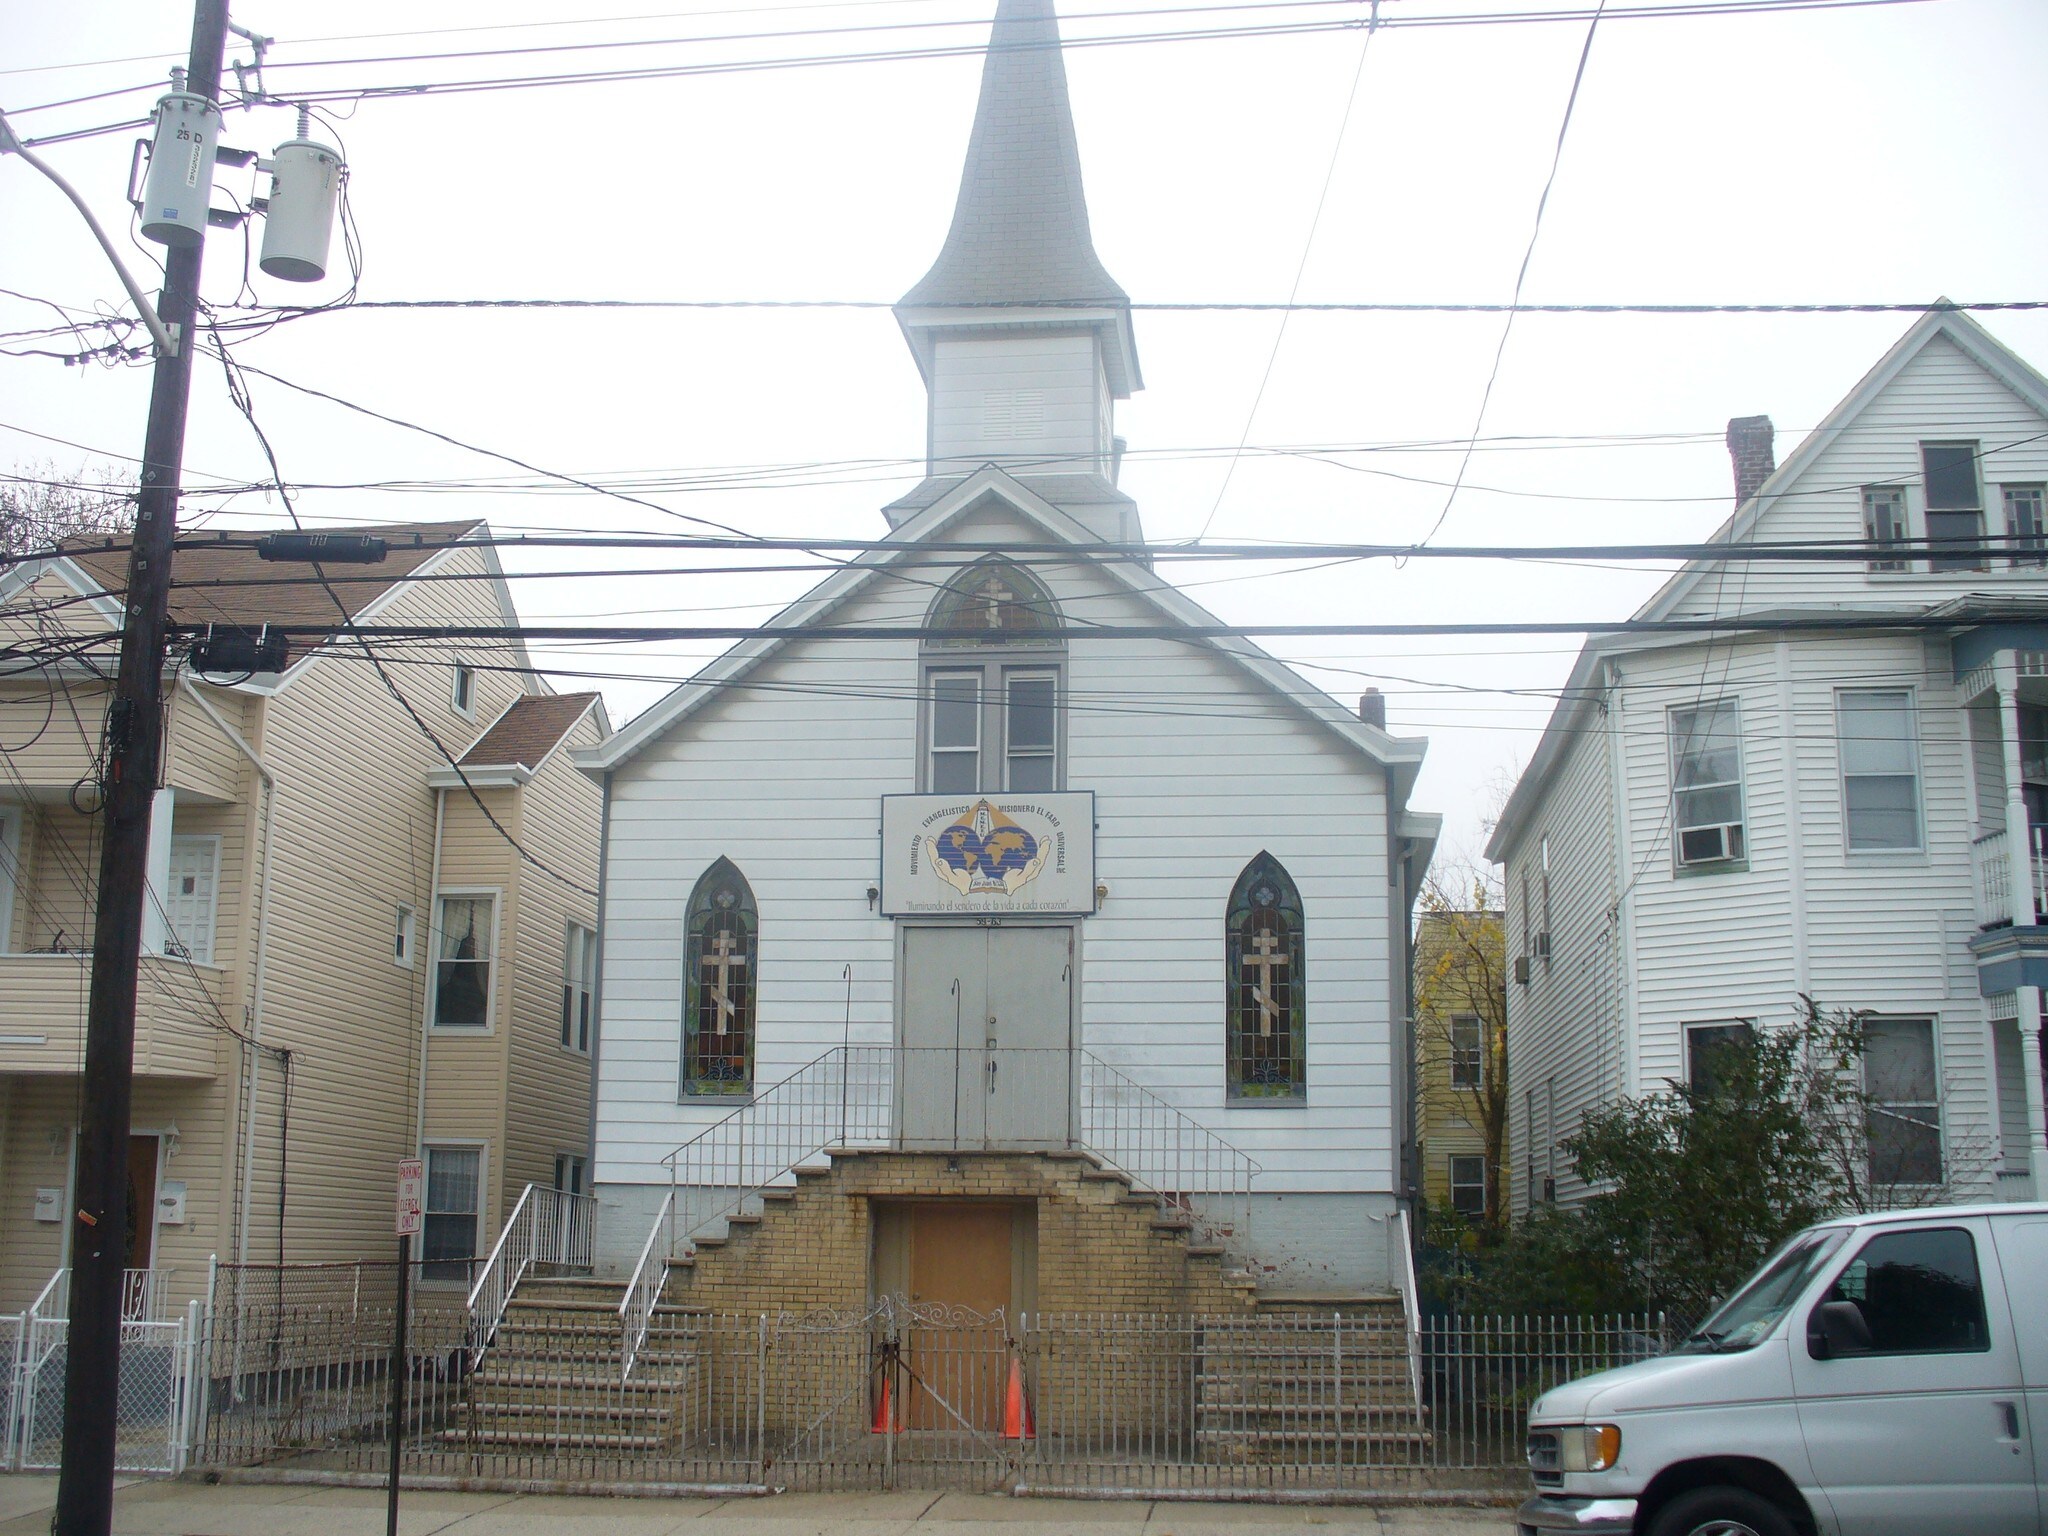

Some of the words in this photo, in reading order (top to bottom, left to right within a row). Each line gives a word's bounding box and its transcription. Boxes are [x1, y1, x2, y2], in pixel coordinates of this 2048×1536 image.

[177, 129, 190, 141] 25
[194, 132, 203, 144] D
[910, 834, 922, 876] MOVIMIENTO
[922, 805, 970, 828] EVANGELISTICO
[998, 805, 1035, 813] MISIONERO
[1036, 807, 1044, 816] EL
[1044, 811, 1061, 828] FARO
[1056, 831, 1065, 867] UNIVERSAL
[946, 900, 953, 911] el
[954, 900, 981, 911] sendero
[982, 900, 992, 911] de
[993, 900, 999, 911] la
[1001, 900, 1015, 911] vida
[1016, 903, 1021, 911] a
[1022, 899, 1038, 911] cada
[401, 1165, 421, 1179] PARKING
[405, 1184, 413, 1194] FOR
[400, 1198, 418, 1212] CLERGY
[402, 1215, 415, 1229] ONLY
